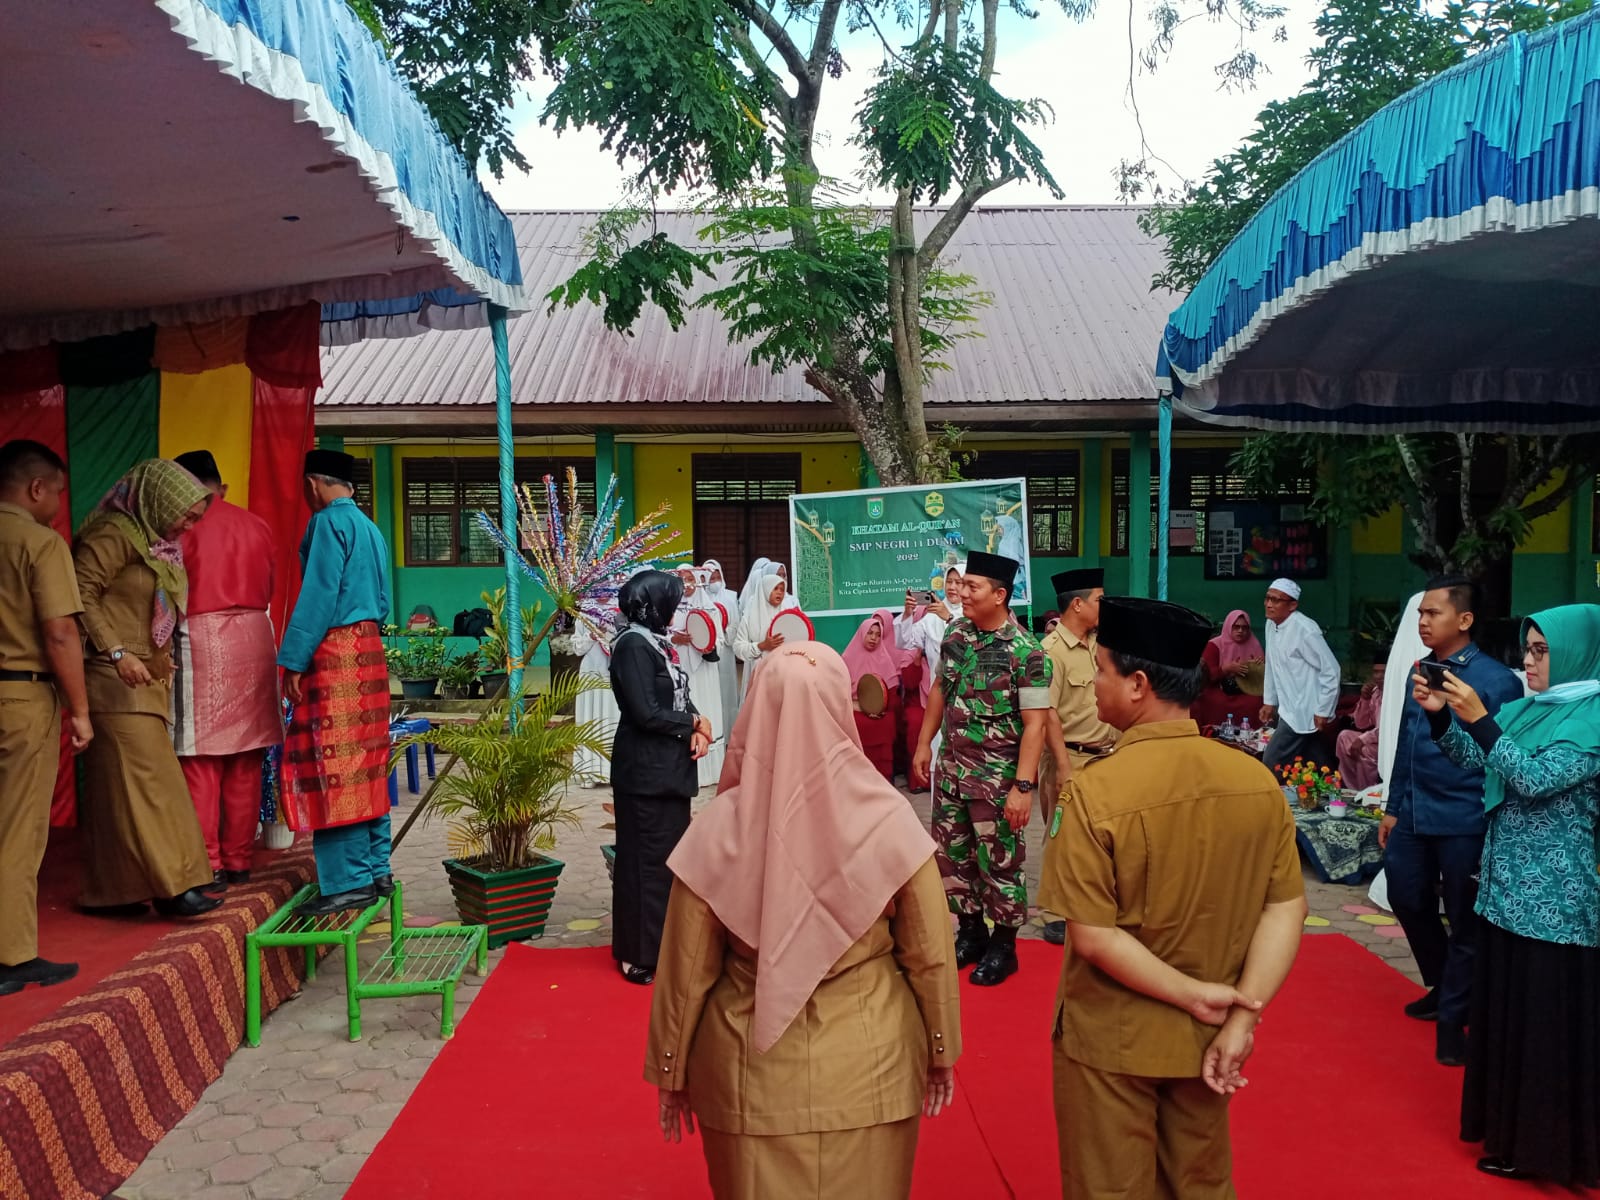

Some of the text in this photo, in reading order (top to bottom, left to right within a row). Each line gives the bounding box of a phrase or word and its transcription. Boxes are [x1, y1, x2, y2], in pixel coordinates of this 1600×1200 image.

[852, 519, 961, 535] KHATAM AL-QUR'AN
[849, 536, 964, 552] SMP NEGRI 11 DUMAI
[896, 553, 919, 562] 2022
[852, 587, 878, 595] Ciptakan
